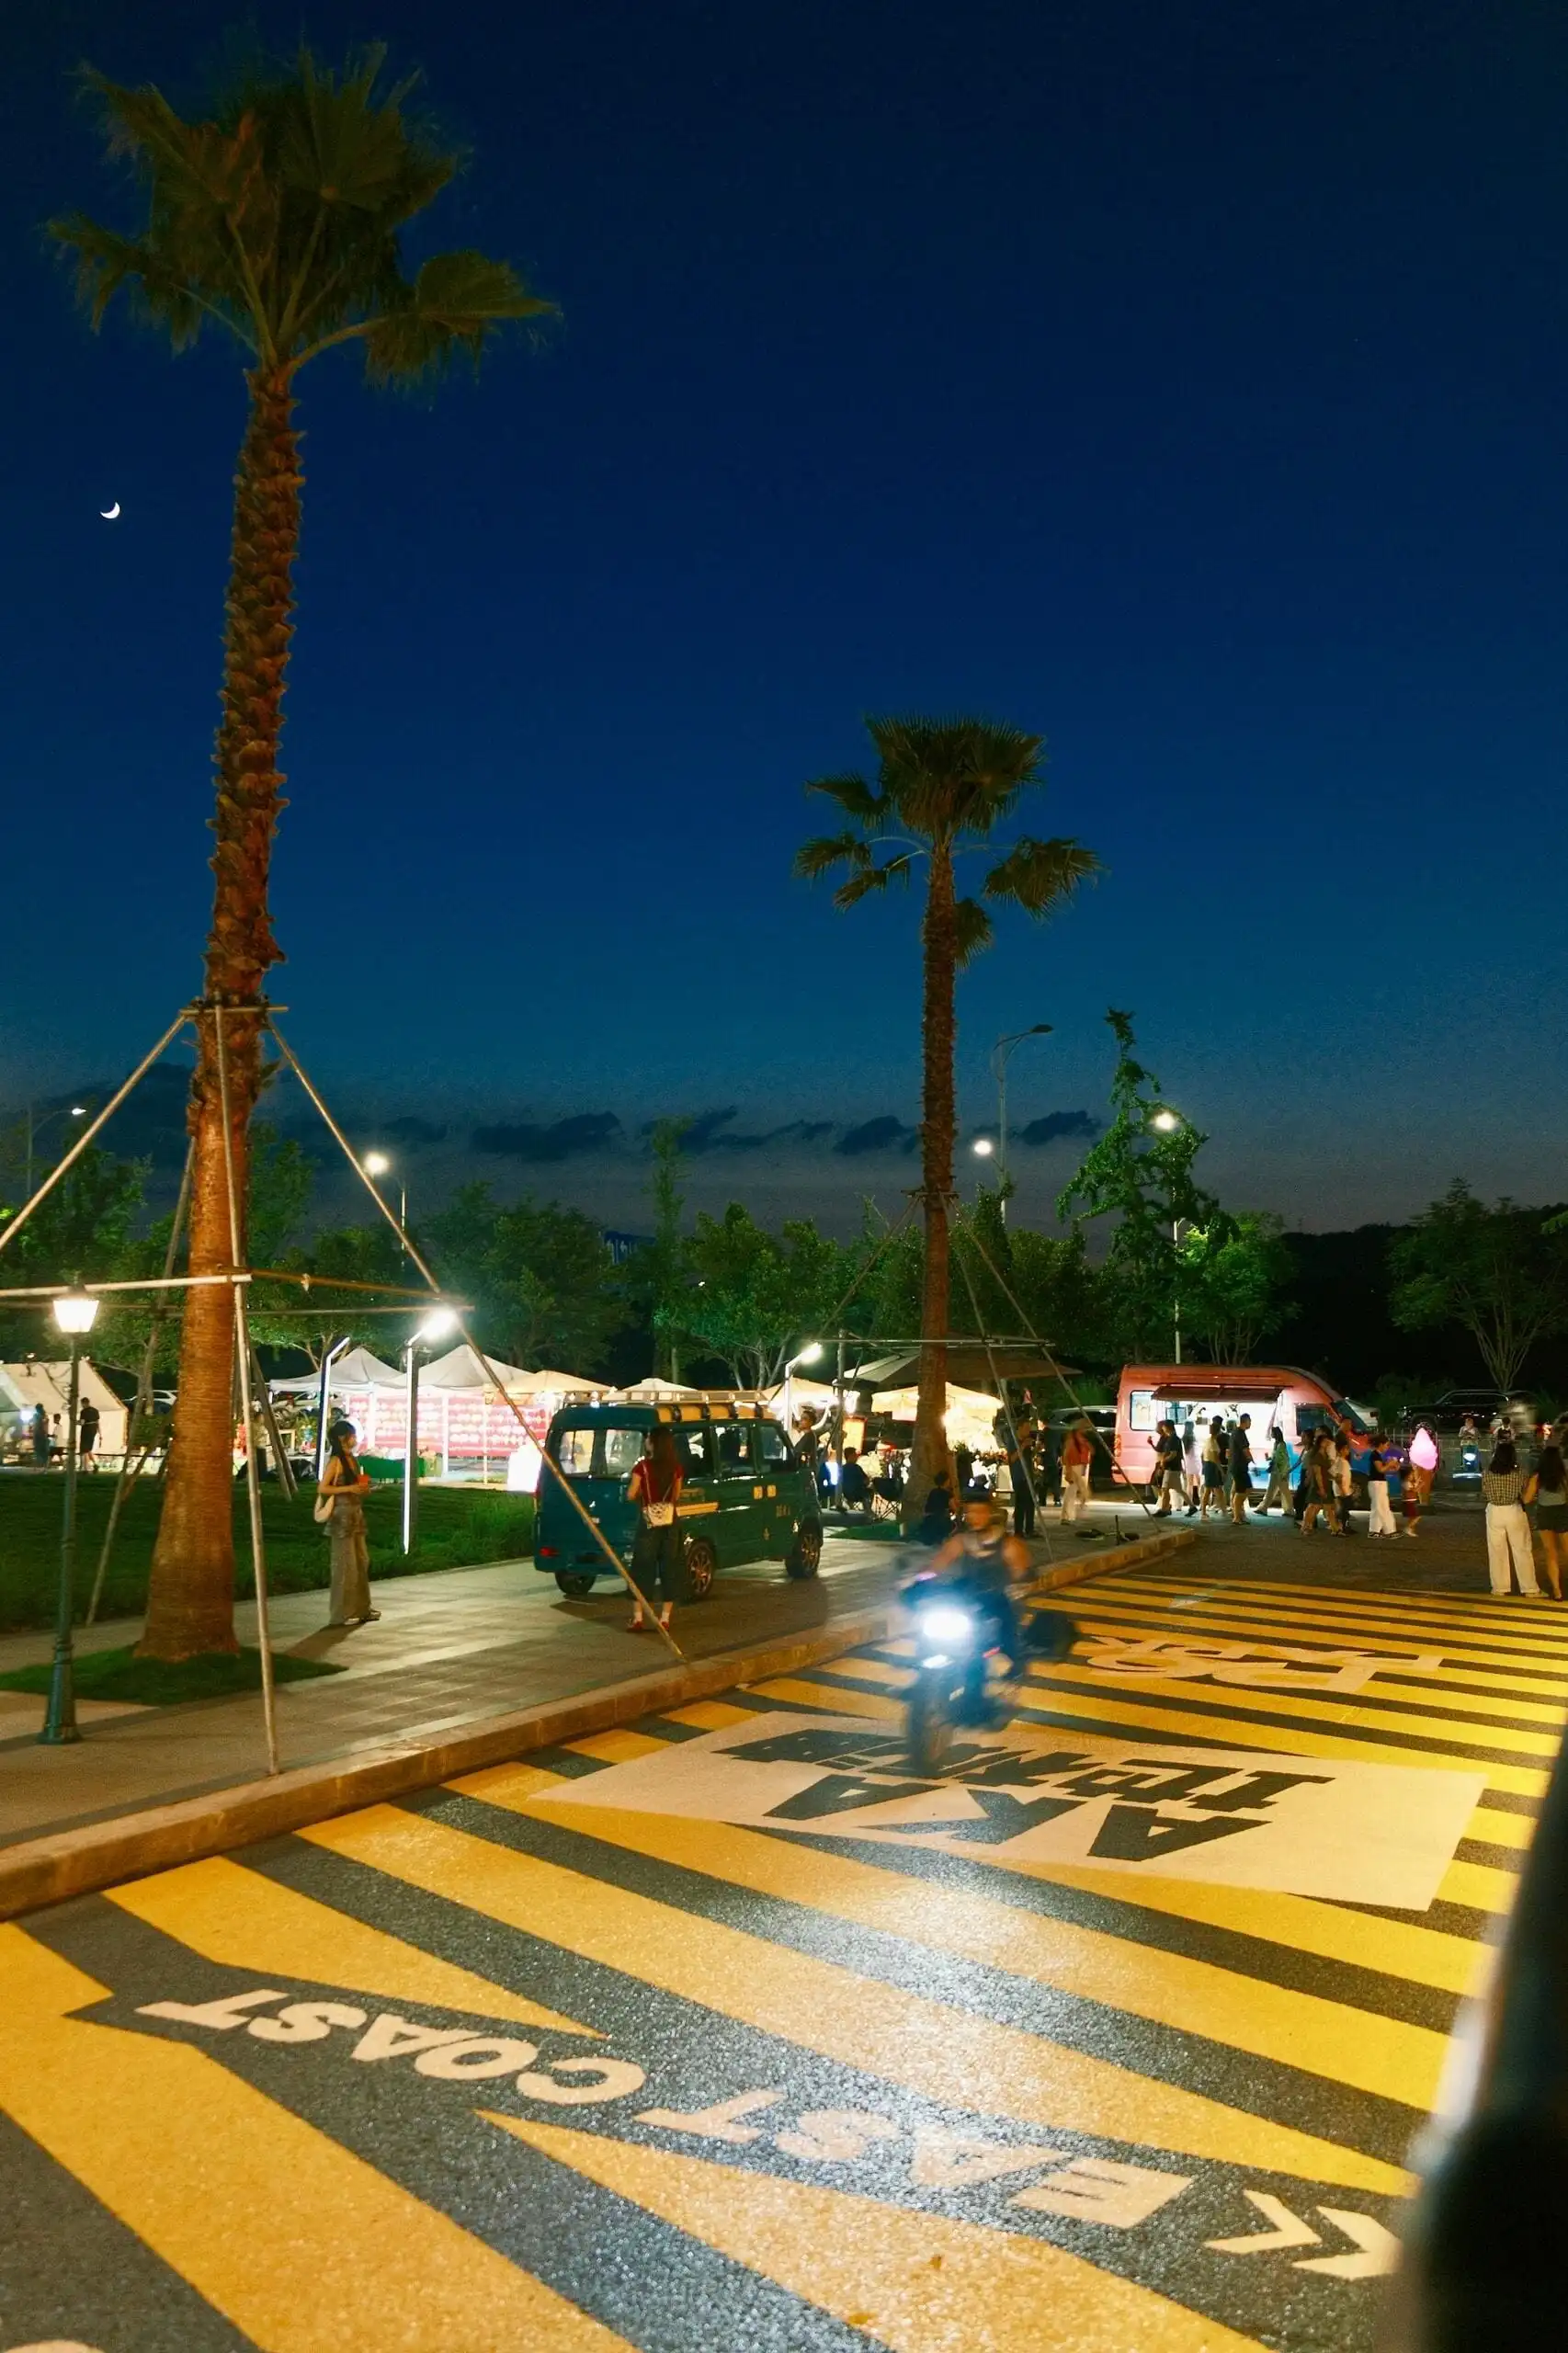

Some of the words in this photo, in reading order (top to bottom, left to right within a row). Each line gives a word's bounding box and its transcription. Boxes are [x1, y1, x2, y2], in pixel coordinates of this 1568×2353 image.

[1090, 1636, 1444, 1673] PARK
[763, 1773, 1272, 1861] AKA
[136, 1988, 645, 2105] COAST
[635, 2088, 1193, 2229] EAST
